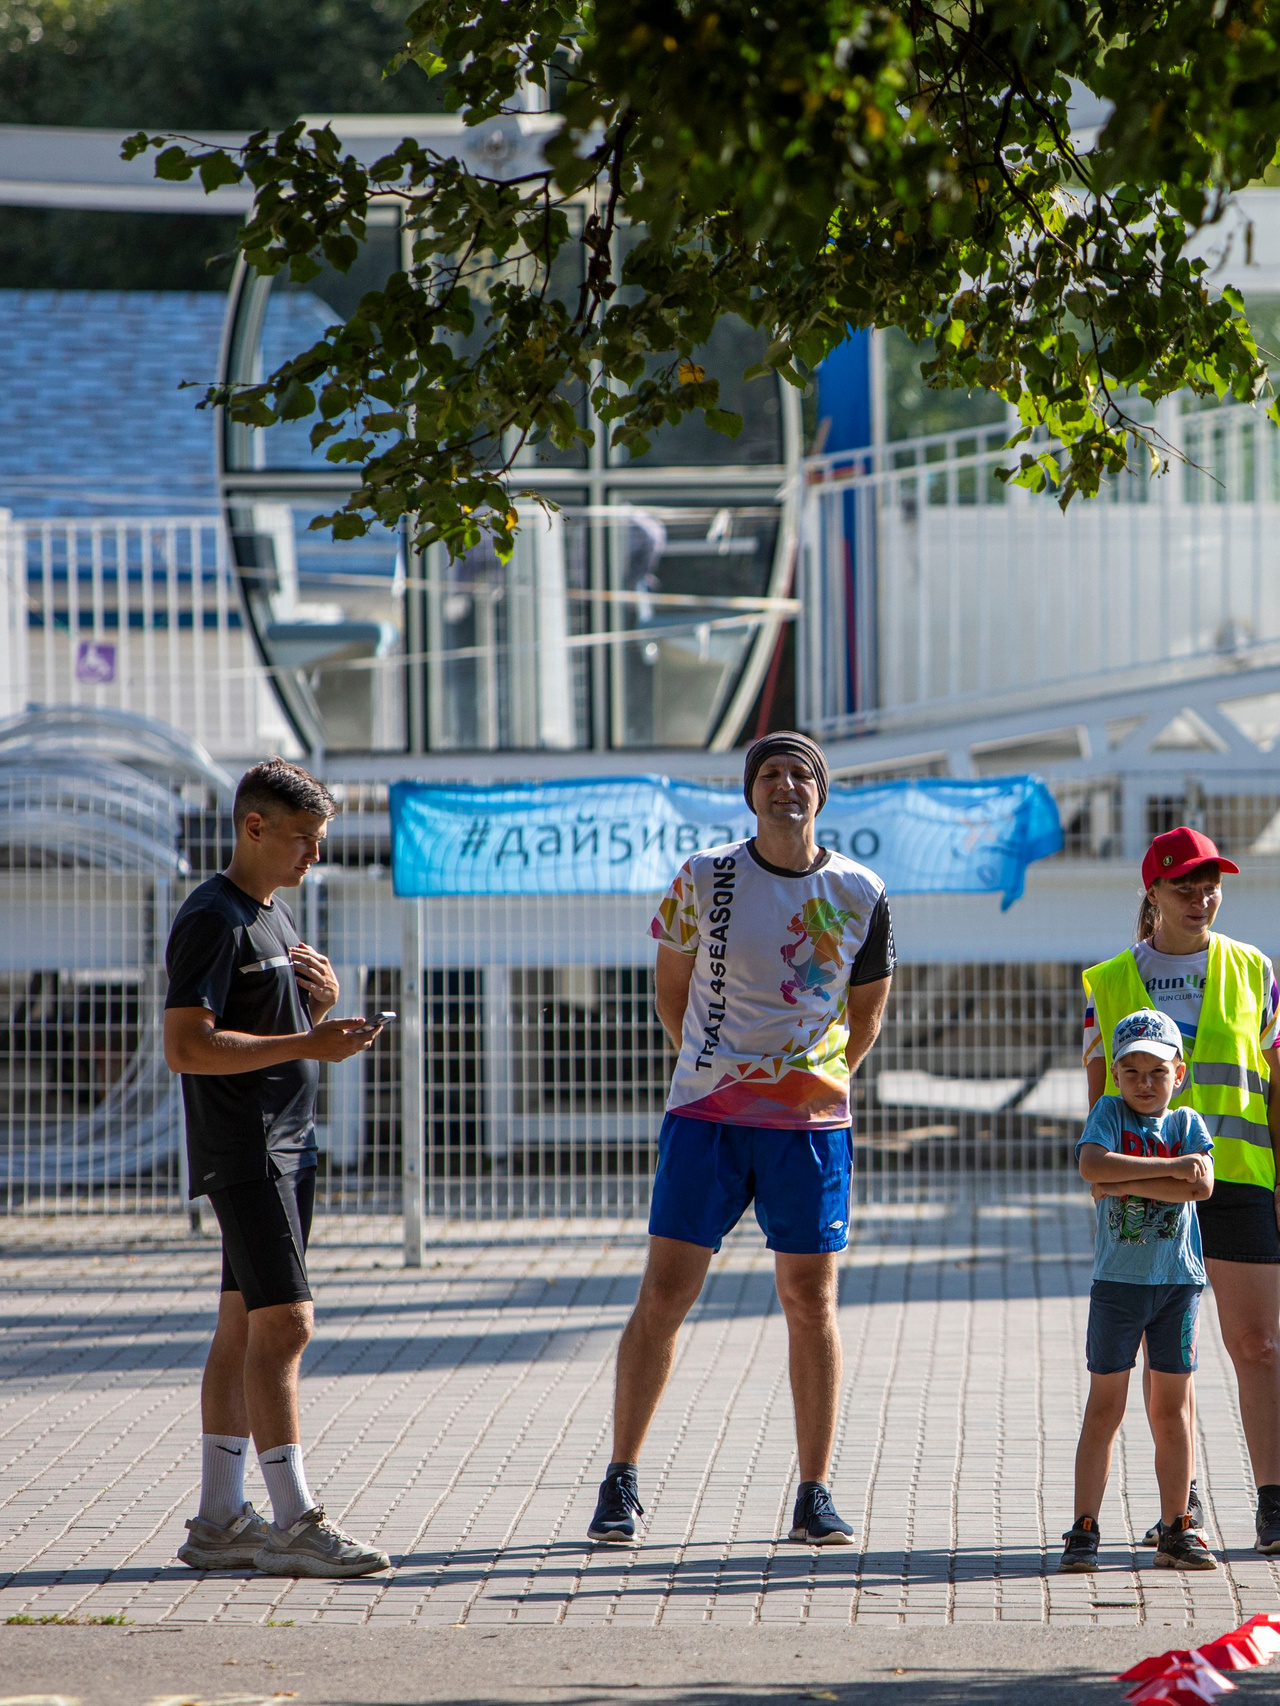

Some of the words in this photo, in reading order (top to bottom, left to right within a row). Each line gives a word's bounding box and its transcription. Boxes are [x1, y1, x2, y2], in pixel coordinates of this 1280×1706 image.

[460, 815, 881, 866] #дай5иваво
[695, 856, 736, 1071] TRAIL4SEASONS
[1158, 994, 1174, 1002] RUN
[1174, 993, 1193, 1001] CLUB
